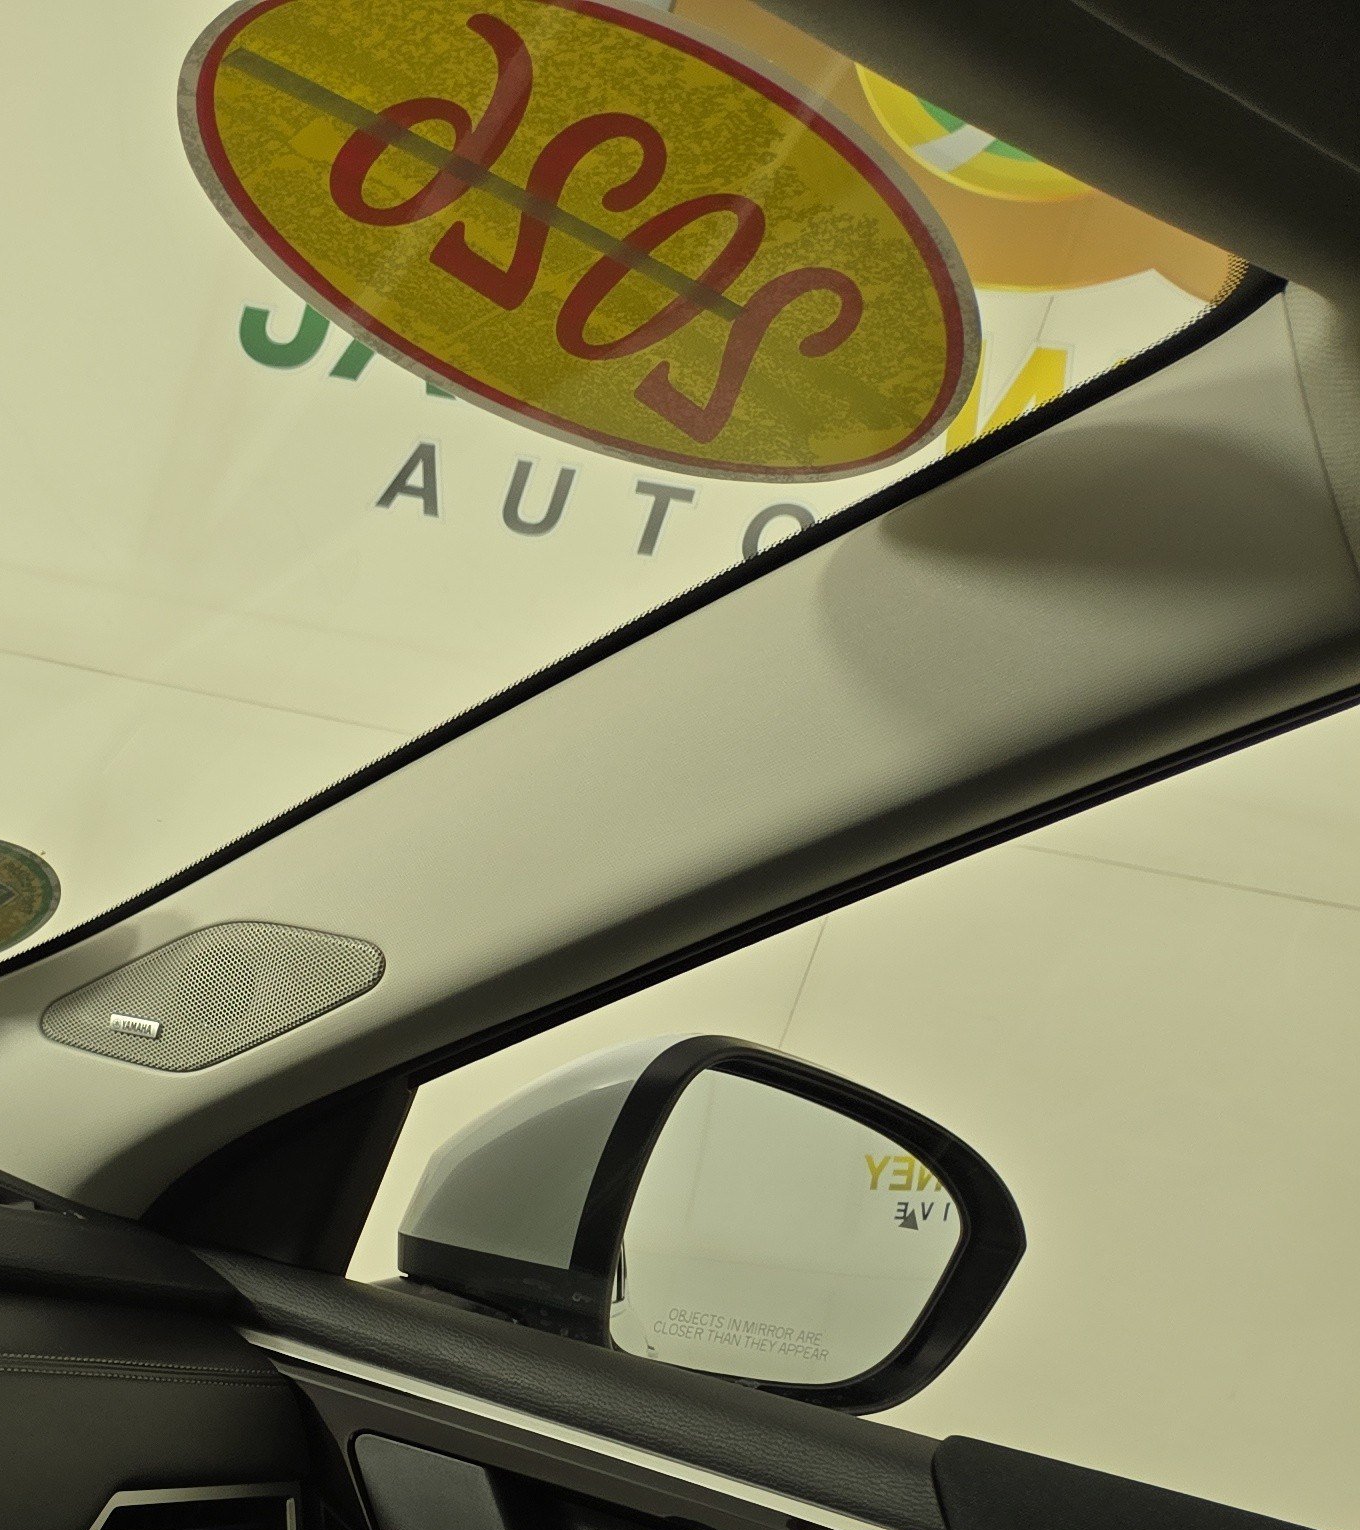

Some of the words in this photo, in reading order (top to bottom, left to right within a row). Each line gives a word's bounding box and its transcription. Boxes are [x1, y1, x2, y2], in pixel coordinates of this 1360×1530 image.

[122, 1020, 152, 1035] YAMAHA
[653, 1320, 704, 1340] CLOSER
[708, 1329, 743, 1347] THAN
[744, 1336, 776, 1352] THEY
[776, 1342, 829, 1361] APPEAR
[669, 1308, 725, 1329] OBJECTS
[728, 1318, 742, 1331] IN
[742, 1320, 795, 1340] MIRROR
[796, 1330, 823, 1346] ARE
